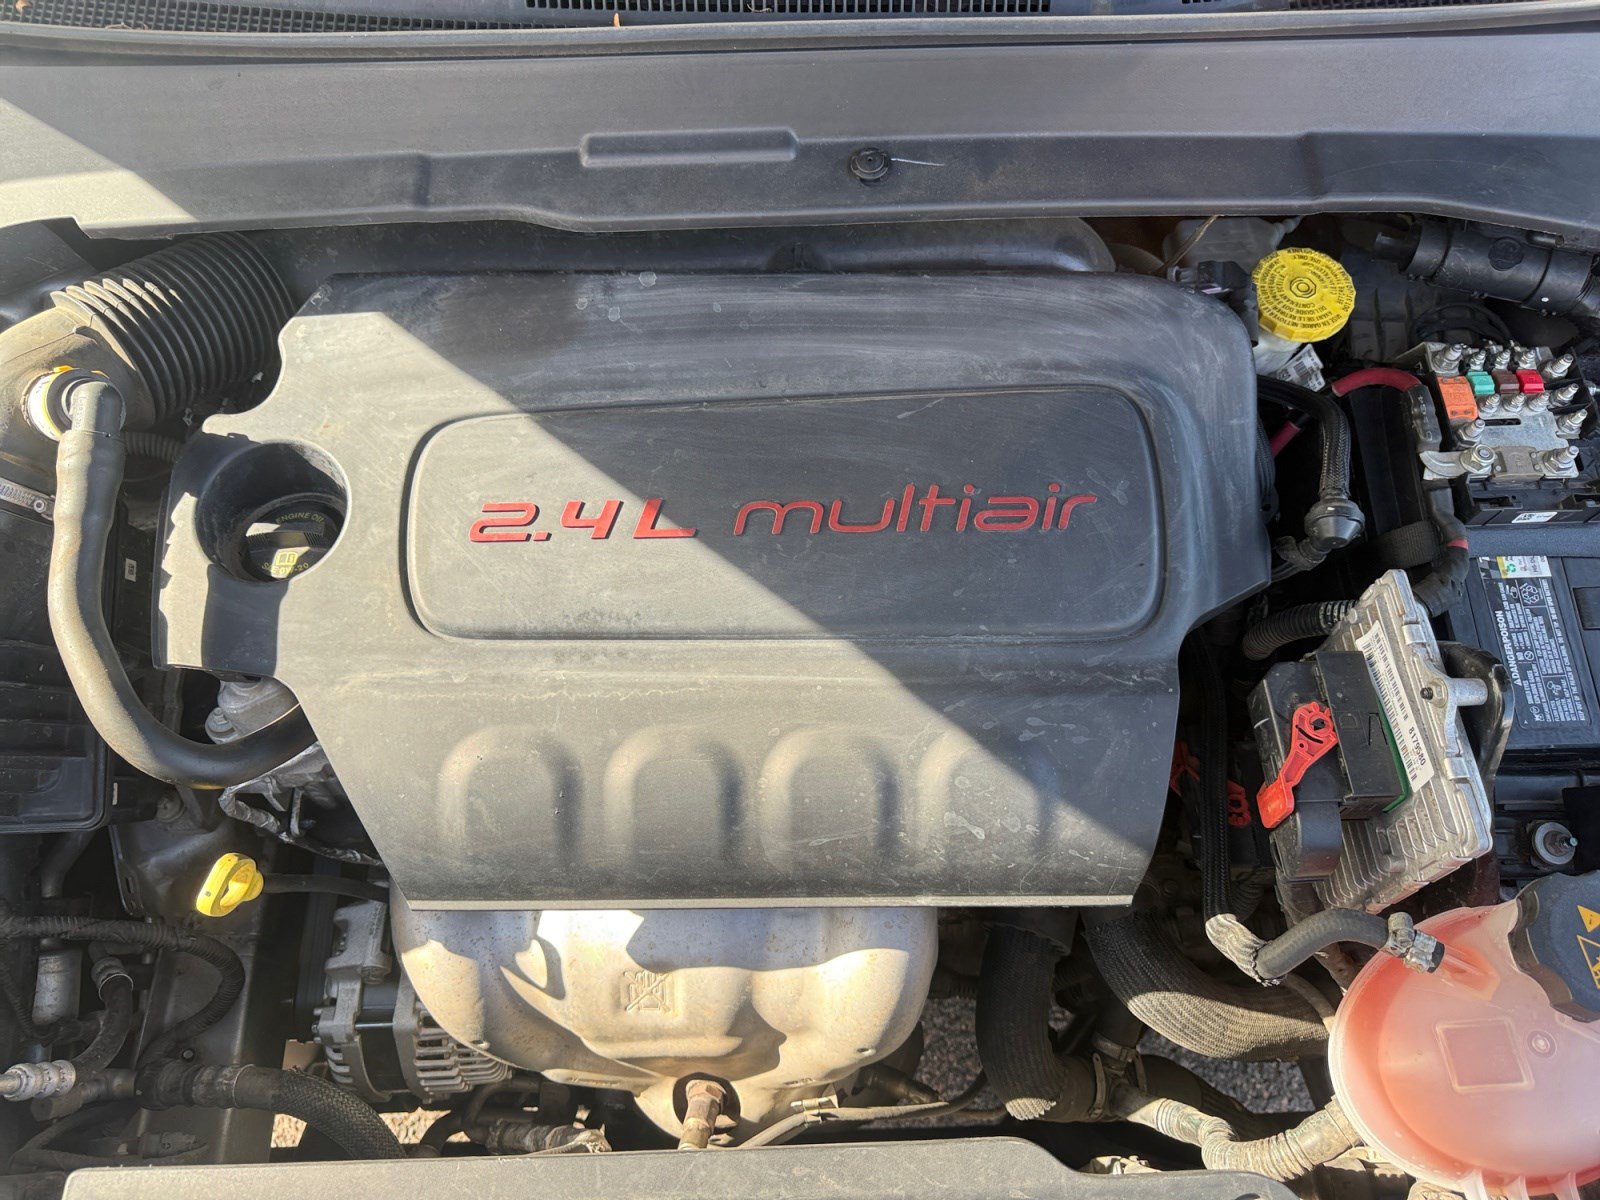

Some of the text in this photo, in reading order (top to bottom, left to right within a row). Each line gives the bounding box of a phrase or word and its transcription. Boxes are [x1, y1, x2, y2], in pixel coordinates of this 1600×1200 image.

[275, 512, 325, 524] ENGINE OIL
[734, 482, 1098, 535] multiair
[262, 562, 279, 573] SAE
[1495, 610, 1520, 678] DANGER/POISON
